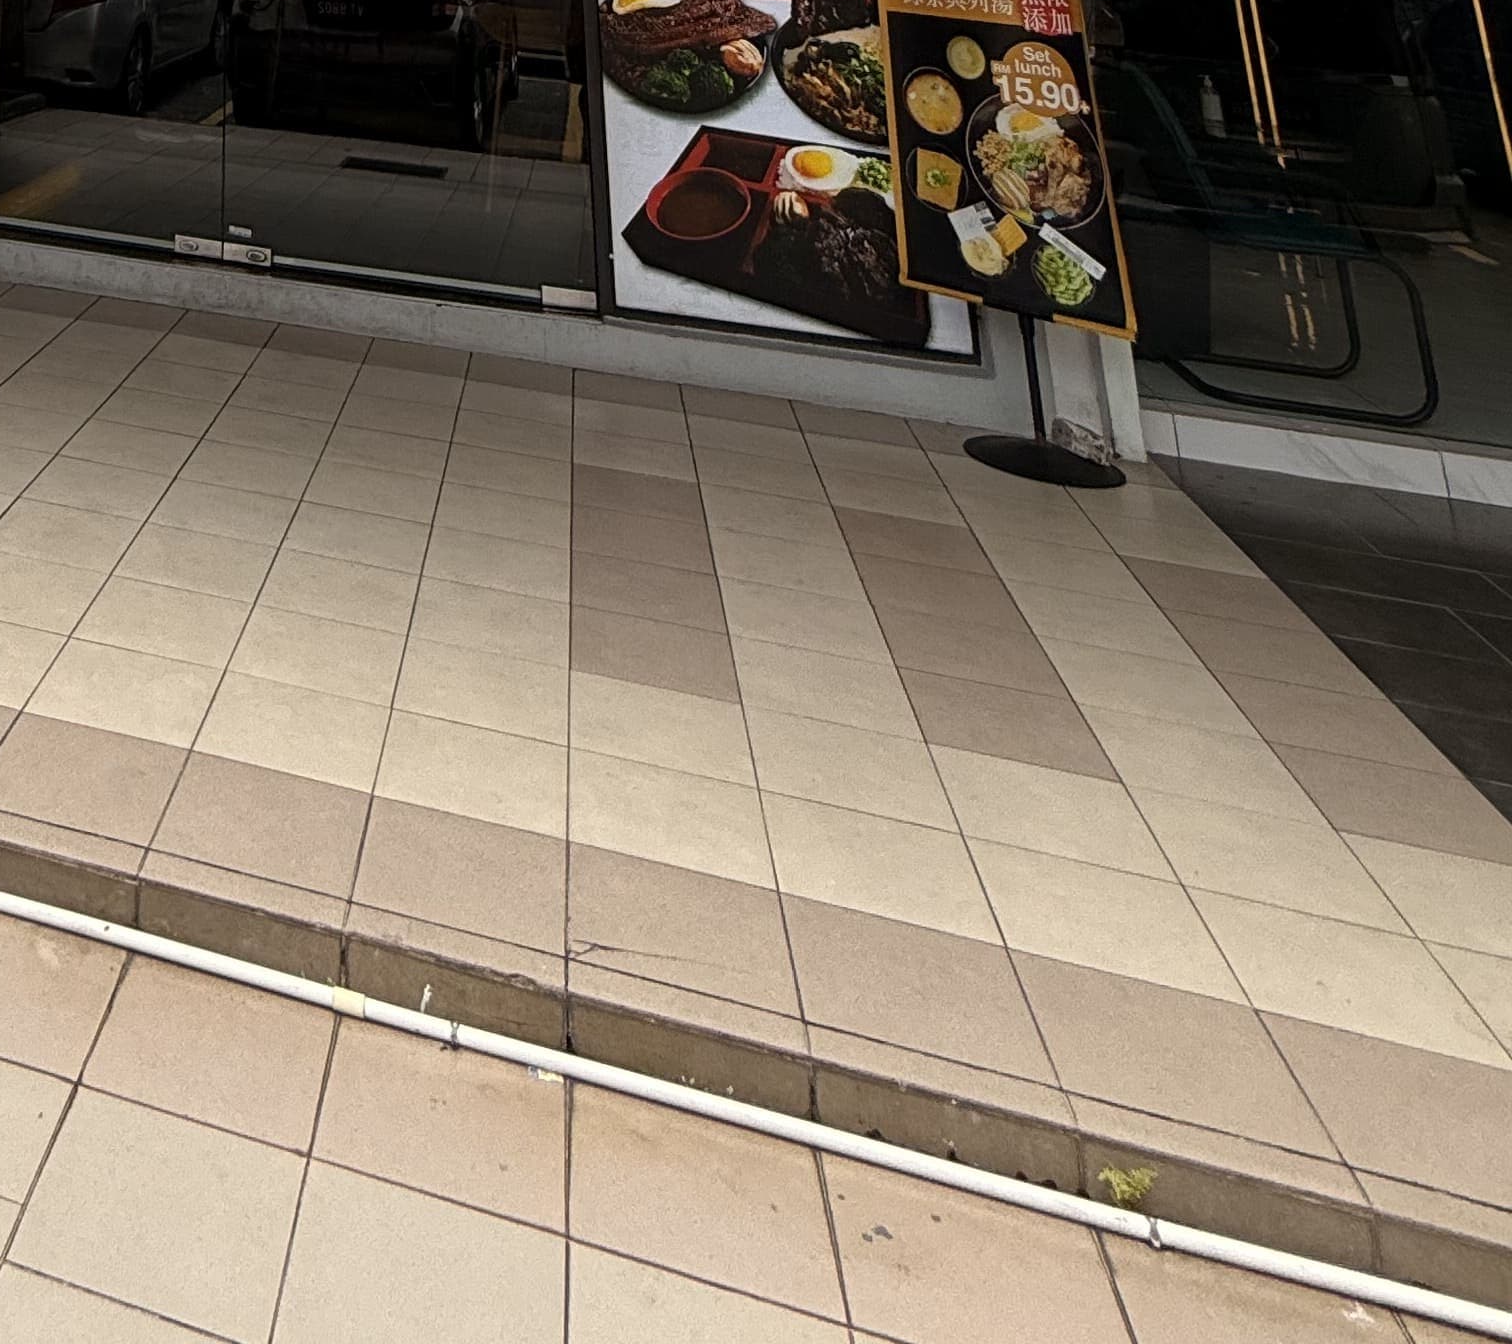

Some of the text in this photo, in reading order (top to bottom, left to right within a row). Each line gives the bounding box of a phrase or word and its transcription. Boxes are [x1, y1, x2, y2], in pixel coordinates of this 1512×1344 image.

[1023, 6, 1074, 37] 添加
[1022, 46, 1051, 64] Set
[1014, 58, 1062, 78] lunch
